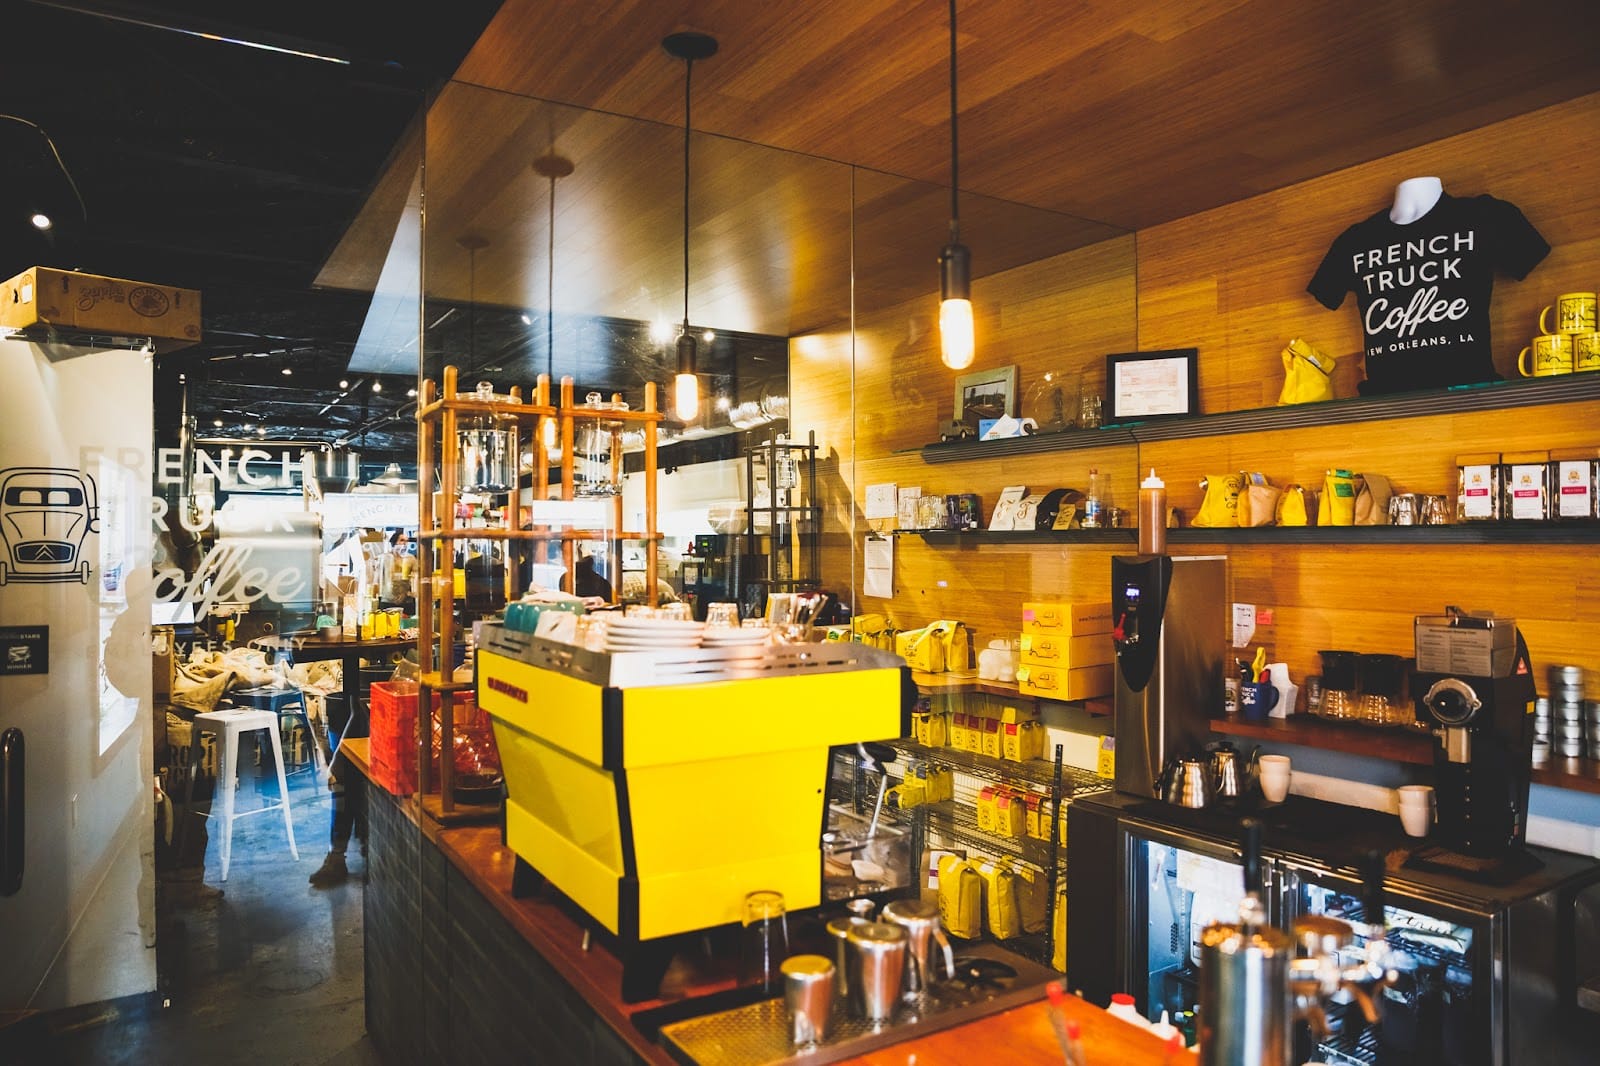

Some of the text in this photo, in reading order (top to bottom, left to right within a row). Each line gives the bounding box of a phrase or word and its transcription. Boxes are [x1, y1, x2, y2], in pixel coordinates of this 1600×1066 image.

[1352, 230, 1475, 274] FRENCH
[1363, 257, 1462, 295] TRUCK
[1365, 285, 1469, 338] Coffee
[1389, 335, 1452, 353] ORLEANS,
[1459, 333, 1474, 343] LA
[141, 495, 295, 532] RUCK
